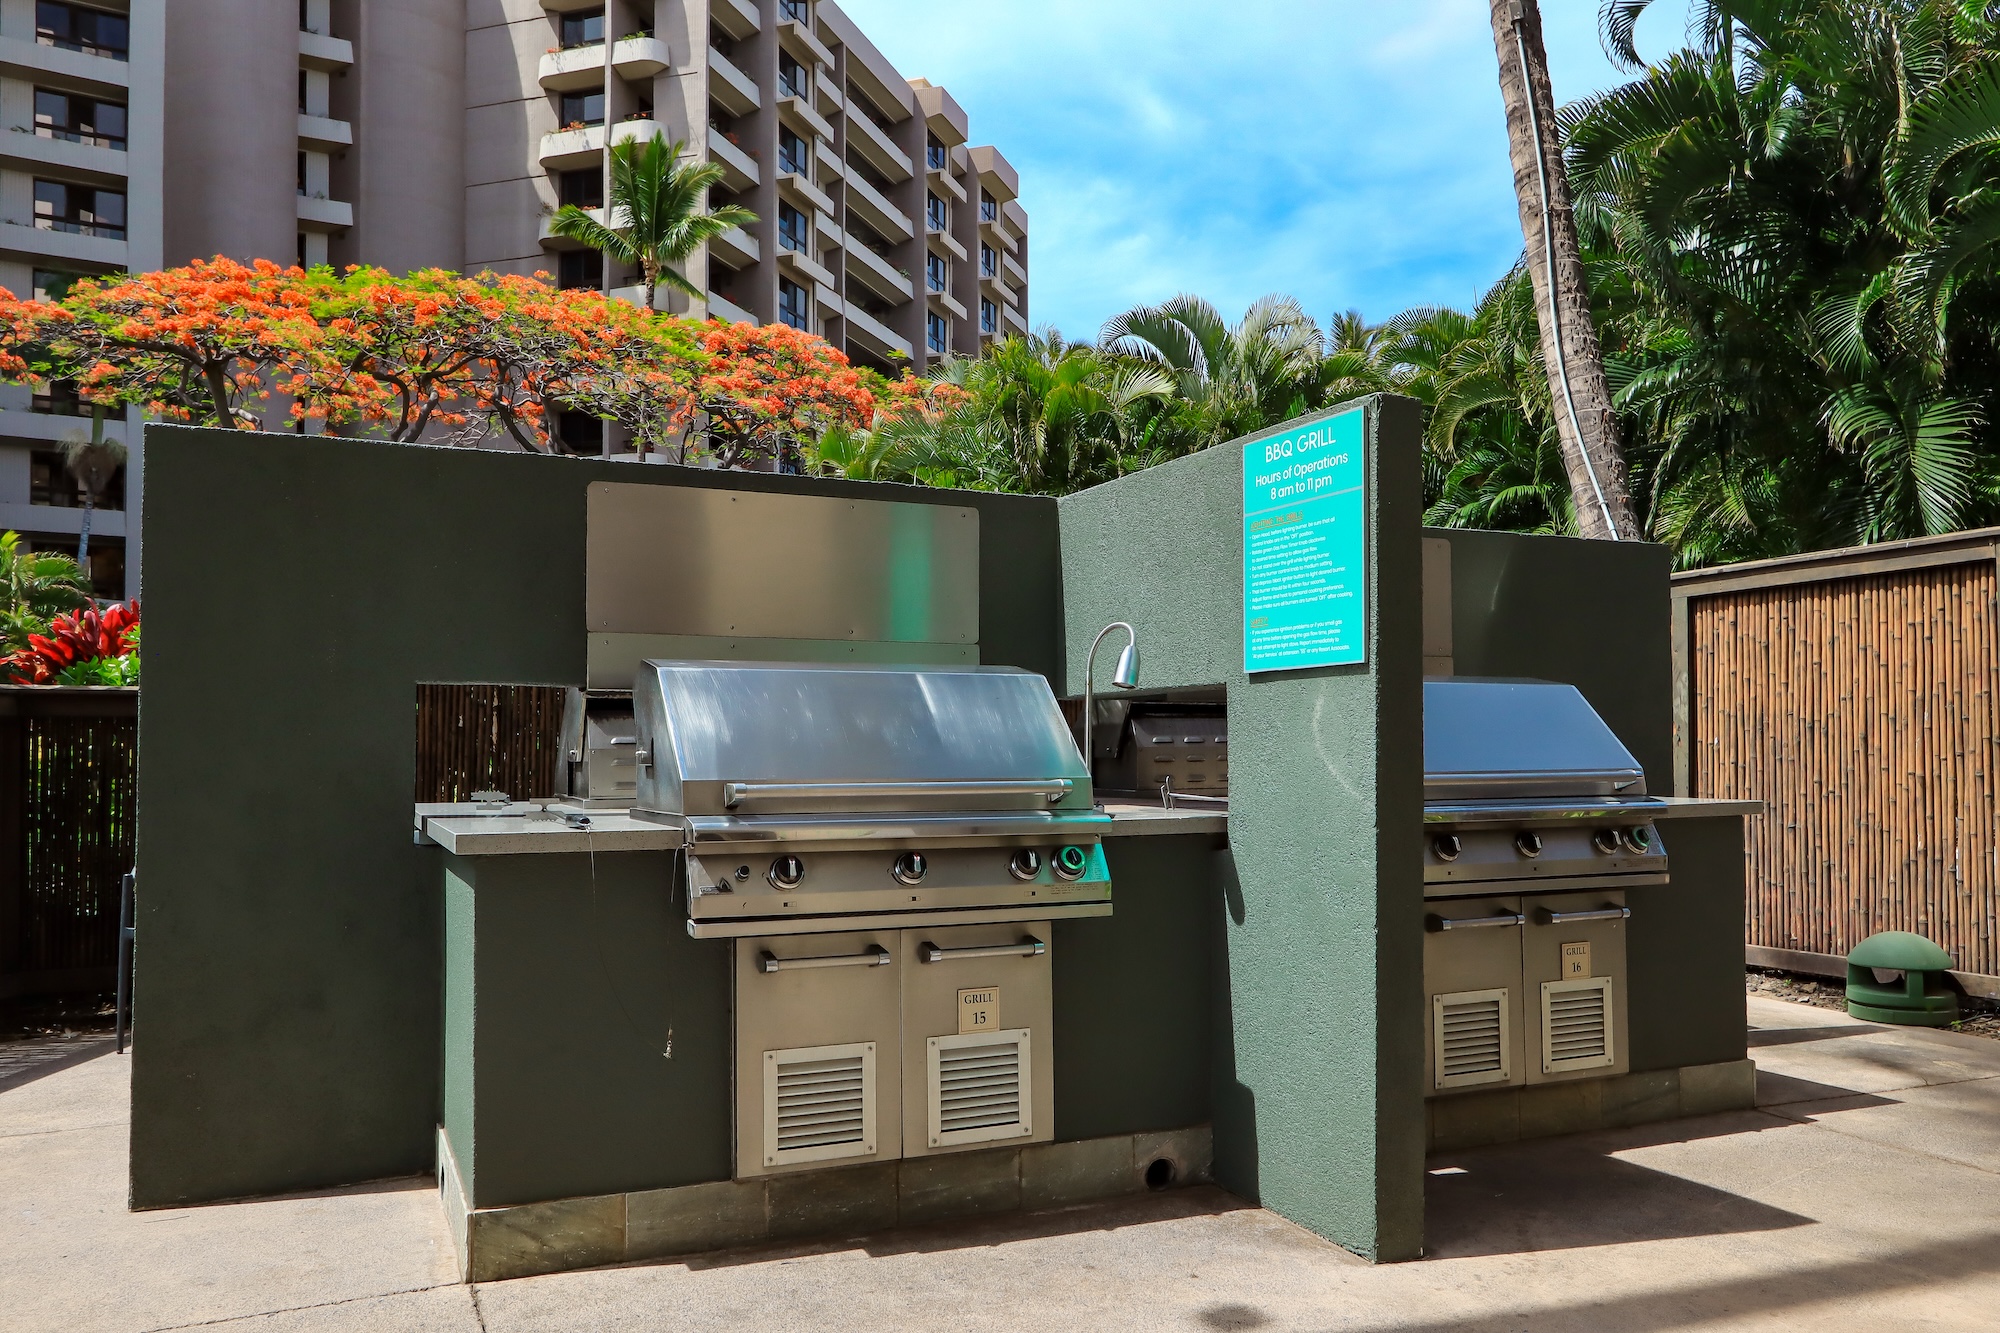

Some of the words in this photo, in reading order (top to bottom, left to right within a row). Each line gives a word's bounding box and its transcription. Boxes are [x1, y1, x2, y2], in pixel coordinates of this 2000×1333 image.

[1265, 440, 1293, 462] BBQ
[1296, 427, 1336, 452] GRILL
[1256, 470, 1281, 487] Hours
[1283, 466, 1292, 479] of
[1294, 452, 1348, 478] Operations
[1270, 488, 1276, 500] 8
[1278, 485, 1294, 498] am
[1296, 482, 1305, 494] to
[1307, 478, 1313, 490] 11
[1315, 475, 1332, 492] pm
[1566, 947, 1586, 956] GRILL
[1572, 962, 1581, 972] 16
[964, 993, 993, 1004] GRILL
[973, 1012, 986, 1024] 15
